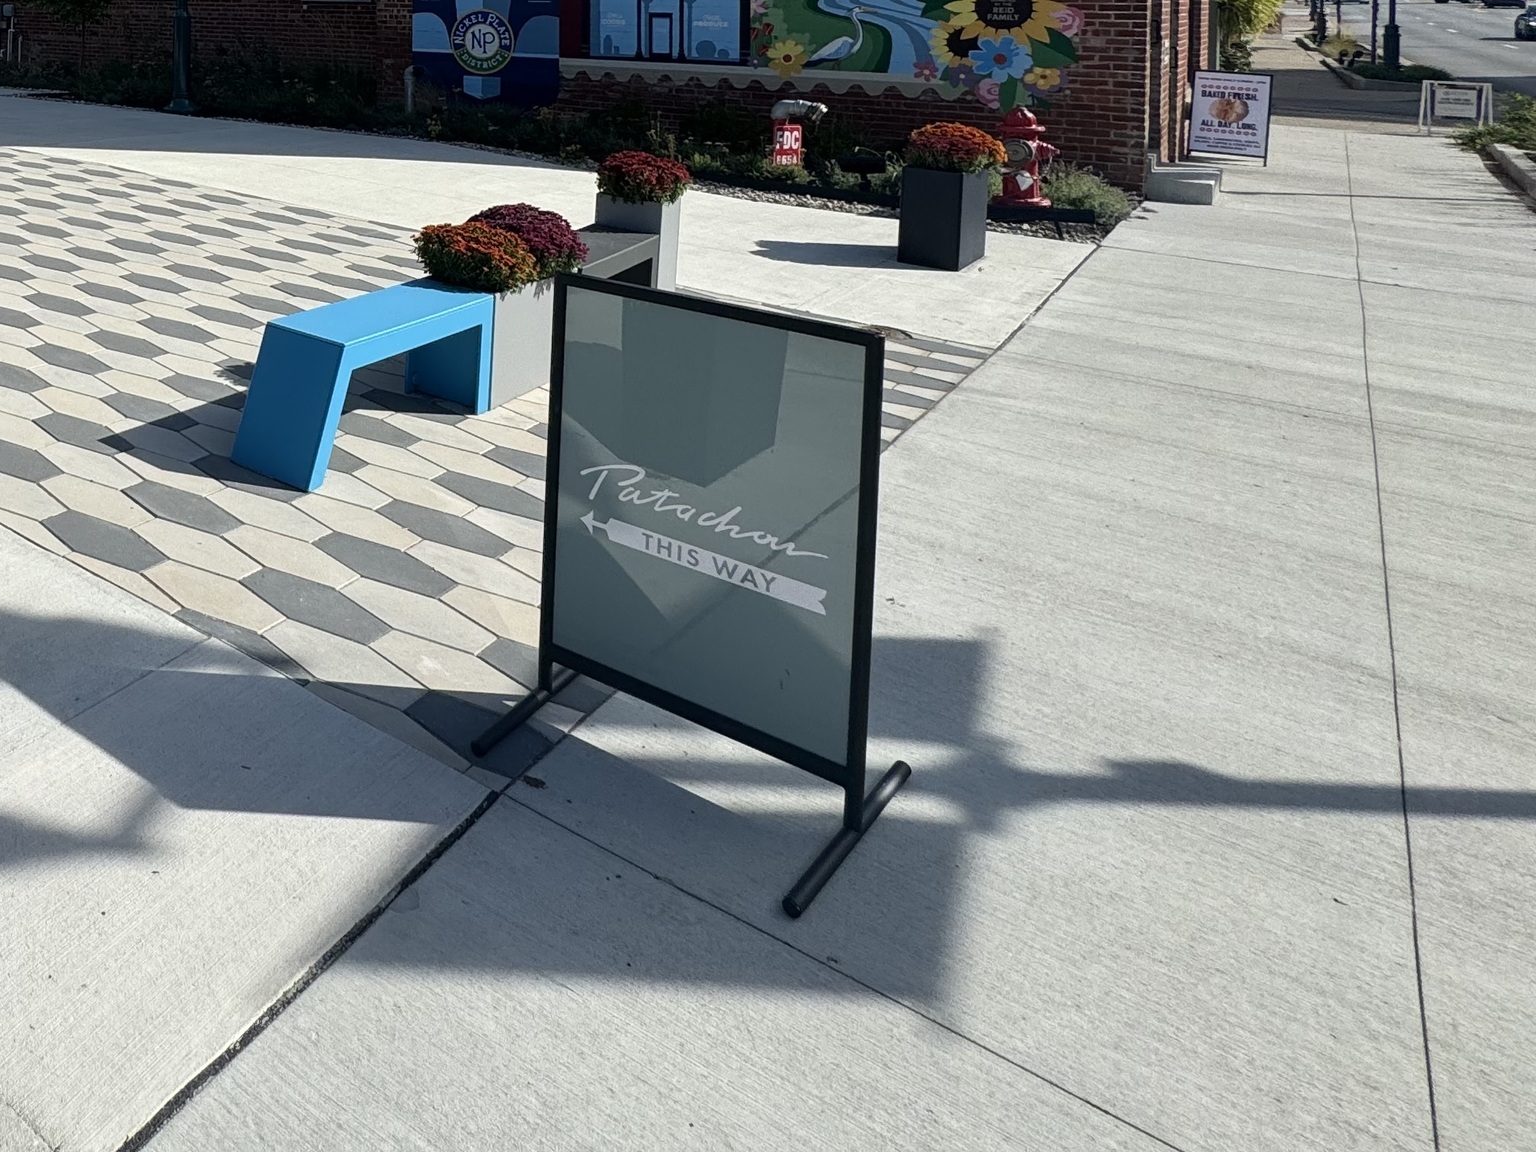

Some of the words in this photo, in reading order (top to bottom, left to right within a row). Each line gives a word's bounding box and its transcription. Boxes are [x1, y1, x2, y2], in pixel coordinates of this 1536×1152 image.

[454, 14, 484, 45] NICKEL
[486, 13, 510, 46] PLATE
[470, 29, 495, 54] NP
[461, 54, 504, 69] DISTRICT
[776, 131, 800, 149] FDC
[641, 533, 699, 567] THIS
[711, 556, 777, 593] WAY
